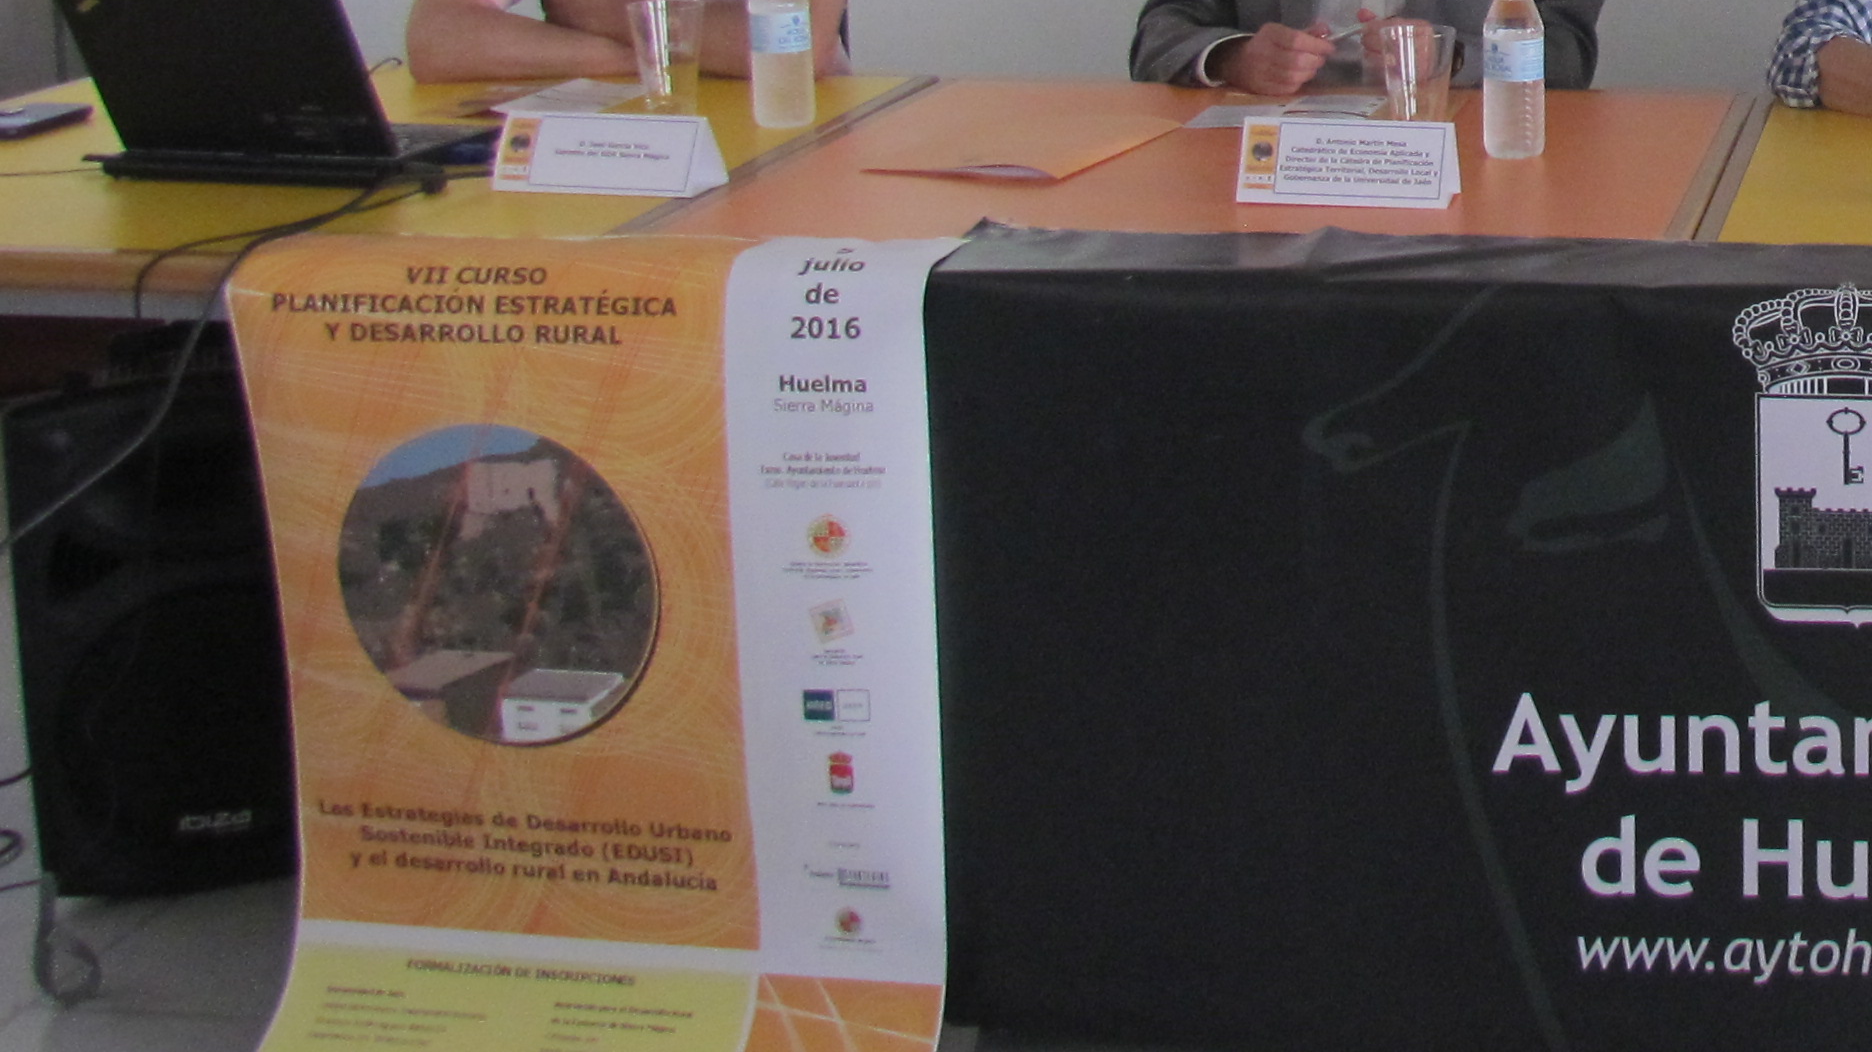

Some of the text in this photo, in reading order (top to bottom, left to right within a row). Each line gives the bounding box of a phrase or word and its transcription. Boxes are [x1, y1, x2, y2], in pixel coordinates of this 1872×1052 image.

[406, 267, 547, 285] VII CURSO
[798, 257, 866, 276] julio
[272, 289, 677, 316] PLANIFICACIÓN ESTRATÉGICA
[805, 282, 840, 304] de
[326, 323, 622, 345] Y DESARROLLO RURAL
[790, 316, 861, 340] 2016
[779, 375, 867, 393] Huelma
[774, 398, 874, 416] Sierra Mágina
[319, 800, 732, 843] Las Estrategias de Desarrollo Urbano
[360, 825, 694, 867] Sostenible Integrado (EDUSI)
[1581, 814, 1701, 897] de
[350, 848, 718, 892] y el desarrollo rural en Andalucía
